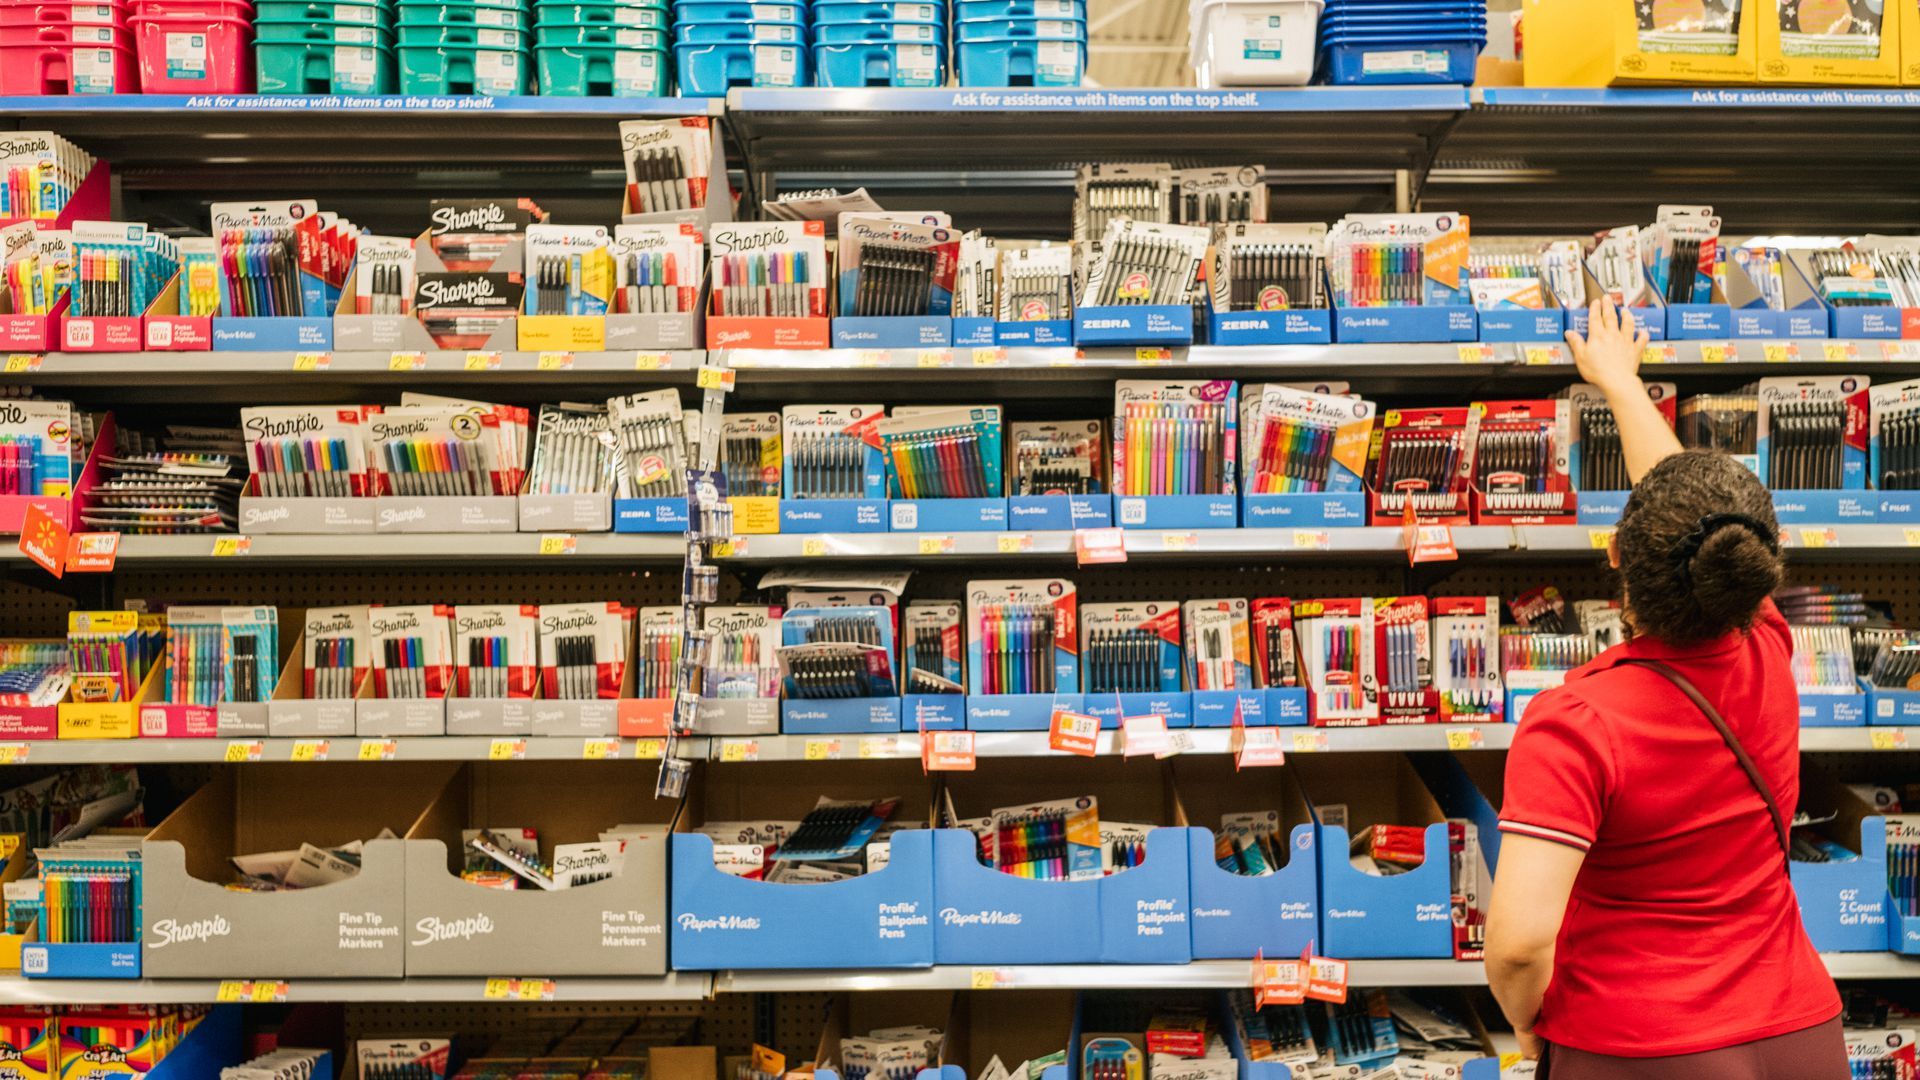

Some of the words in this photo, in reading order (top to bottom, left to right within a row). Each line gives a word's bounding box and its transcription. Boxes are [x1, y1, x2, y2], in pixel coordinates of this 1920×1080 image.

[187, 96, 213, 108] Ask
[214, 96, 236, 108] for
[237, 96, 308, 108] assistance
[310, 96, 341, 108] with
[343, 96, 382, 108] items
[384, 98, 403, 108] on
[405, 97, 429, 108] the
[431, 98, 456, 111] top
[458, 96, 495, 109] shelf.
[952, 93, 979, 106] Ask
[980, 93, 1001, 106] for
[1002, 94, 1073, 106] assistance
[1075, 93, 1106, 106] with
[1108, 93, 1147, 106] items
[1149, 95, 1168, 106] on
[1170, 93, 1193, 106] the
[1195, 94, 1220, 109] top
[1222, 93, 1259, 106] shelf.
[1692, 91, 1717, 102] Ask
[1718, 91, 1739, 102] for
[1741, 91, 1809, 103] assistance
[1811, 91, 1842, 103] with
[1844, 92, 1883, 104] items
[1885, 94, 1904, 104] on
[1905, 92, 1920, 104] th
[623, 128, 672, 152] Sharpie
[0, 138, 49, 159] Sharpie
[215, 212, 250, 229] Paper
[257, 214, 289, 227] Mate
[431, 203, 506, 236] Sharpie
[854, 224, 892, 240] Paper
[899, 231, 931, 246] Mate
[1347, 222, 1389, 238] Paper
[1395, 223, 1431, 236] Mate
[529, 233, 562, 247] Paper
[617, 234, 668, 256] Sharpie
[714, 227, 789, 258] Sharpie
[360, 247, 412, 264] Sharpie
[417, 276, 495, 310] Sharpie
[1082, 319, 1131, 329] ZEBRA
[1221, 320, 1270, 330] ZEBRA
[71, 333, 91, 343] GEAR
[716, 329, 752, 345] Sharpie
[1119, 389, 1150, 402] Paper
[1157, 390, 1185, 401] Mate
[1205, 383, 1226, 397] Flair
[1764, 387, 1801, 403] Paper
[1808, 388, 1837, 400] Mate
[1268, 391, 1303, 412] Paper
[1313, 404, 1346, 419] Mate
[246, 413, 323, 442] Sharpie
[460, 418, 471, 430] 2
[541, 412, 609, 436] Sharpie
[786, 415, 817, 429] Paper
[373, 420, 429, 442] Sharpie
[620, 510, 651, 518] ZEBRA
[1888, 504, 1911, 513] PILOT
[244, 506, 290, 526] Sharpie
[379, 506, 426, 526] Sharpie
[896, 514, 913, 524] GEAR
[26, 540, 57, 569] Rollback
[79, 558, 111, 566] Rollback
[972, 590, 1007, 606] Paper
[1084, 610, 1114, 624] Paper
[1374, 601, 1425, 626] Sharpie
[308, 619, 354, 638] Sharpie
[372, 616, 420, 638] Sharpie
[458, 615, 506, 636] Sharpie
[542, 613, 597, 636] Sharpie
[708, 613, 768, 636] Sharpie
[1326, 718, 1368, 727] uni-ball
[1451, 714, 1491, 723] uni-ball
[1061, 738, 1092, 751] Rollback
[1100, 832, 1146, 845] Sharpie
[554, 851, 610, 875] Sharpie
[1840, 890, 1856, 900] G2
[879, 902, 916, 914] Profile
[1137, 900, 1173, 912] Profile
[1192, 908, 1214, 918] Paper
[1281, 902, 1307, 912] Profile
[1416, 904, 1442, 913] Profile
[1840, 902, 1846, 912] 2
[1848, 902, 1882, 912] Count
[339, 912, 362, 925] Fine
[364, 912, 382, 928] Tip
[602, 910, 626, 922] Fine
[627, 910, 645, 925] Tip
[879, 915, 928, 927] Ballpoint
[940, 908, 978, 927] Paper
[981, 910, 1022, 925] Mate
[1137, 912, 1186, 924] Ballpoint
[1281, 911, 1295, 920] Gel
[1296, 911, 1314, 920] Pens
[1328, 909, 1350, 919] Paper
[1416, 912, 1430, 922] Gel
[1431, 912, 1448, 922] Pens
[1840, 914, 1858, 925] Gel
[1860, 914, 1885, 925] Pens
[412, 912, 495, 946] Sharpie
[602, 923, 662, 935] Permanent
[678, 912, 720, 932] Paper
[723, 916, 760, 930] Mate
[147, 914, 230, 949] Sharpie
[339, 926, 399, 937] Permanent
[879, 928, 906, 939] Pens
[1138, 925, 1163, 936] Pens
[339, 937, 384, 949] Markers
[602, 935, 647, 947] Markers
[28, 958, 44, 968] GEAR
[1268, 988, 1299, 998] Rollback
[1310, 984, 1342, 997] Rollback
[1854, 1044, 1884, 1056] Mate
